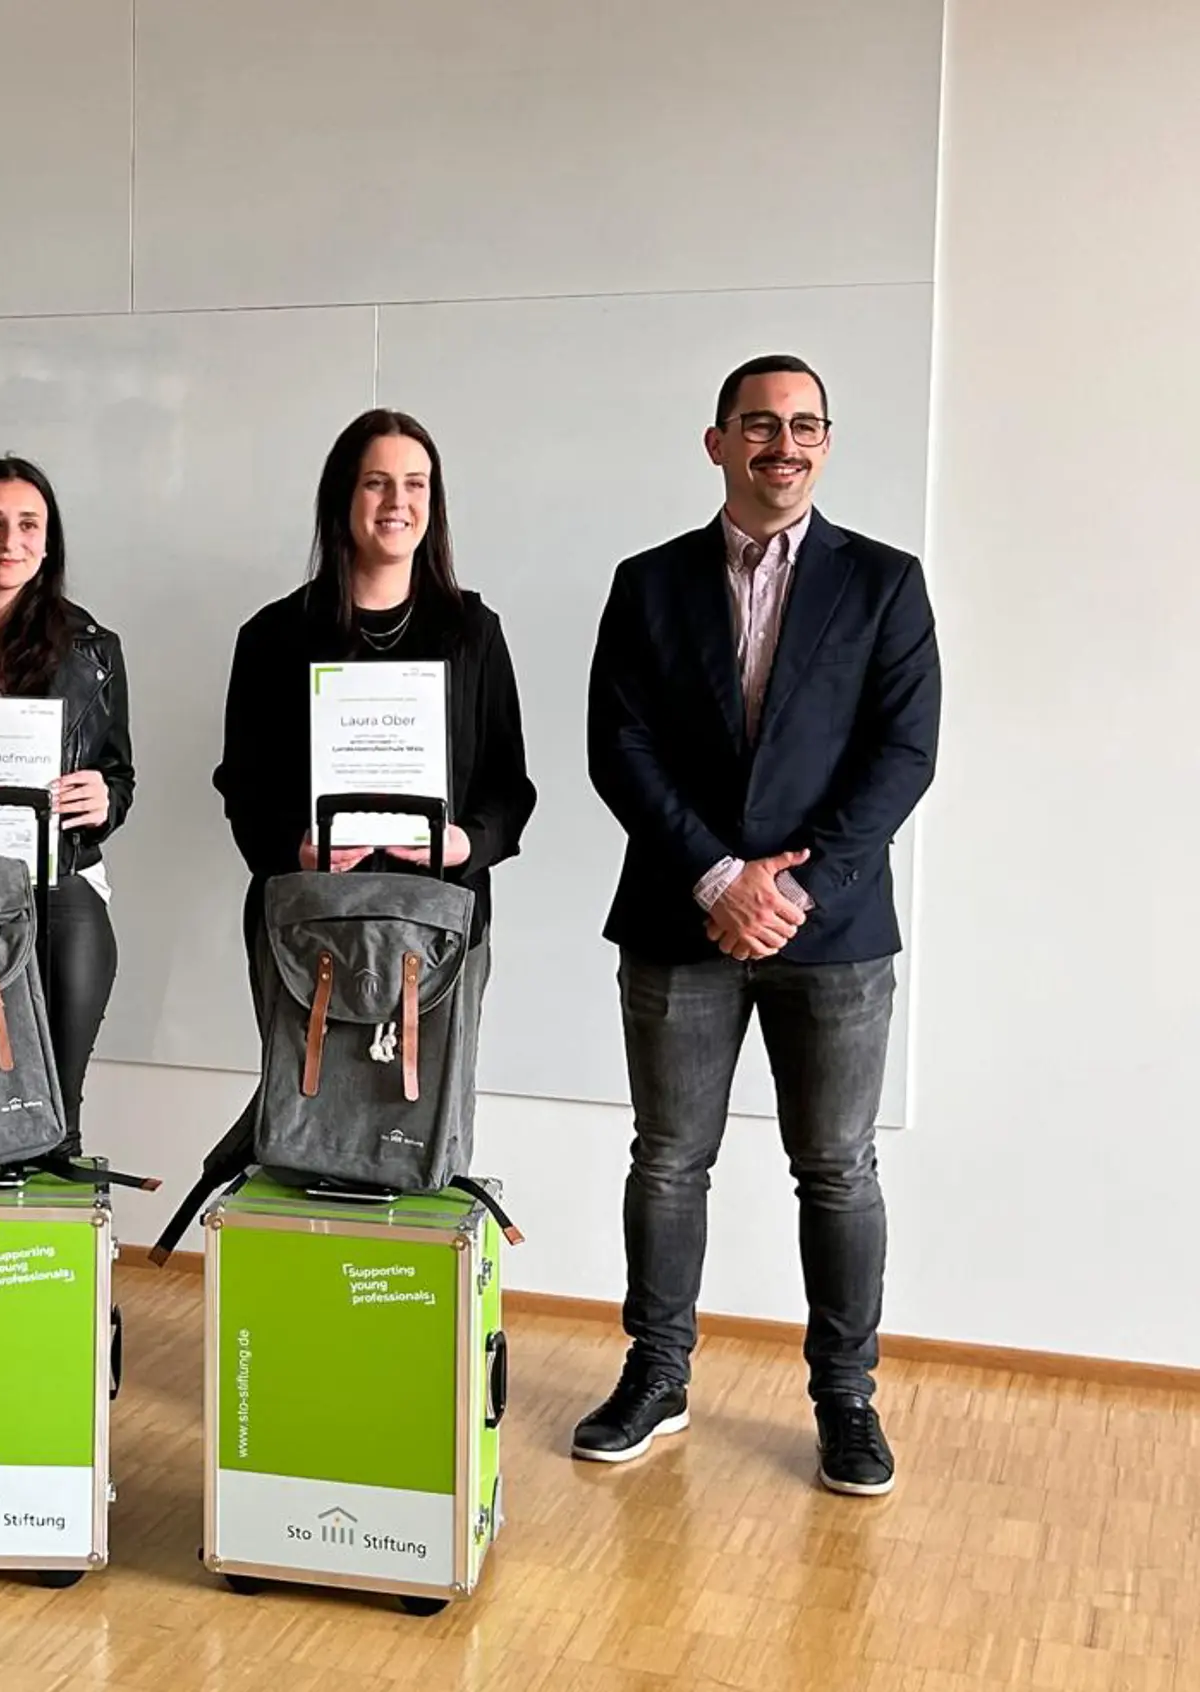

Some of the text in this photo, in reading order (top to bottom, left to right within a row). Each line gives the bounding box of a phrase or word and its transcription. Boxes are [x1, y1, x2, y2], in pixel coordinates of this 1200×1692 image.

[340, 714, 416, 727] Laura Ober
[349, 1264, 415, 1280] Supporting
[350, 1279, 388, 1292] young
[353, 1291, 429, 1305] professionals
[237, 1329, 252, 1458] www.sto-stiftung.de
[3, 1513, 66, 1530] Stiftung
[287, 1525, 427, 1557] Sto Stiftung
